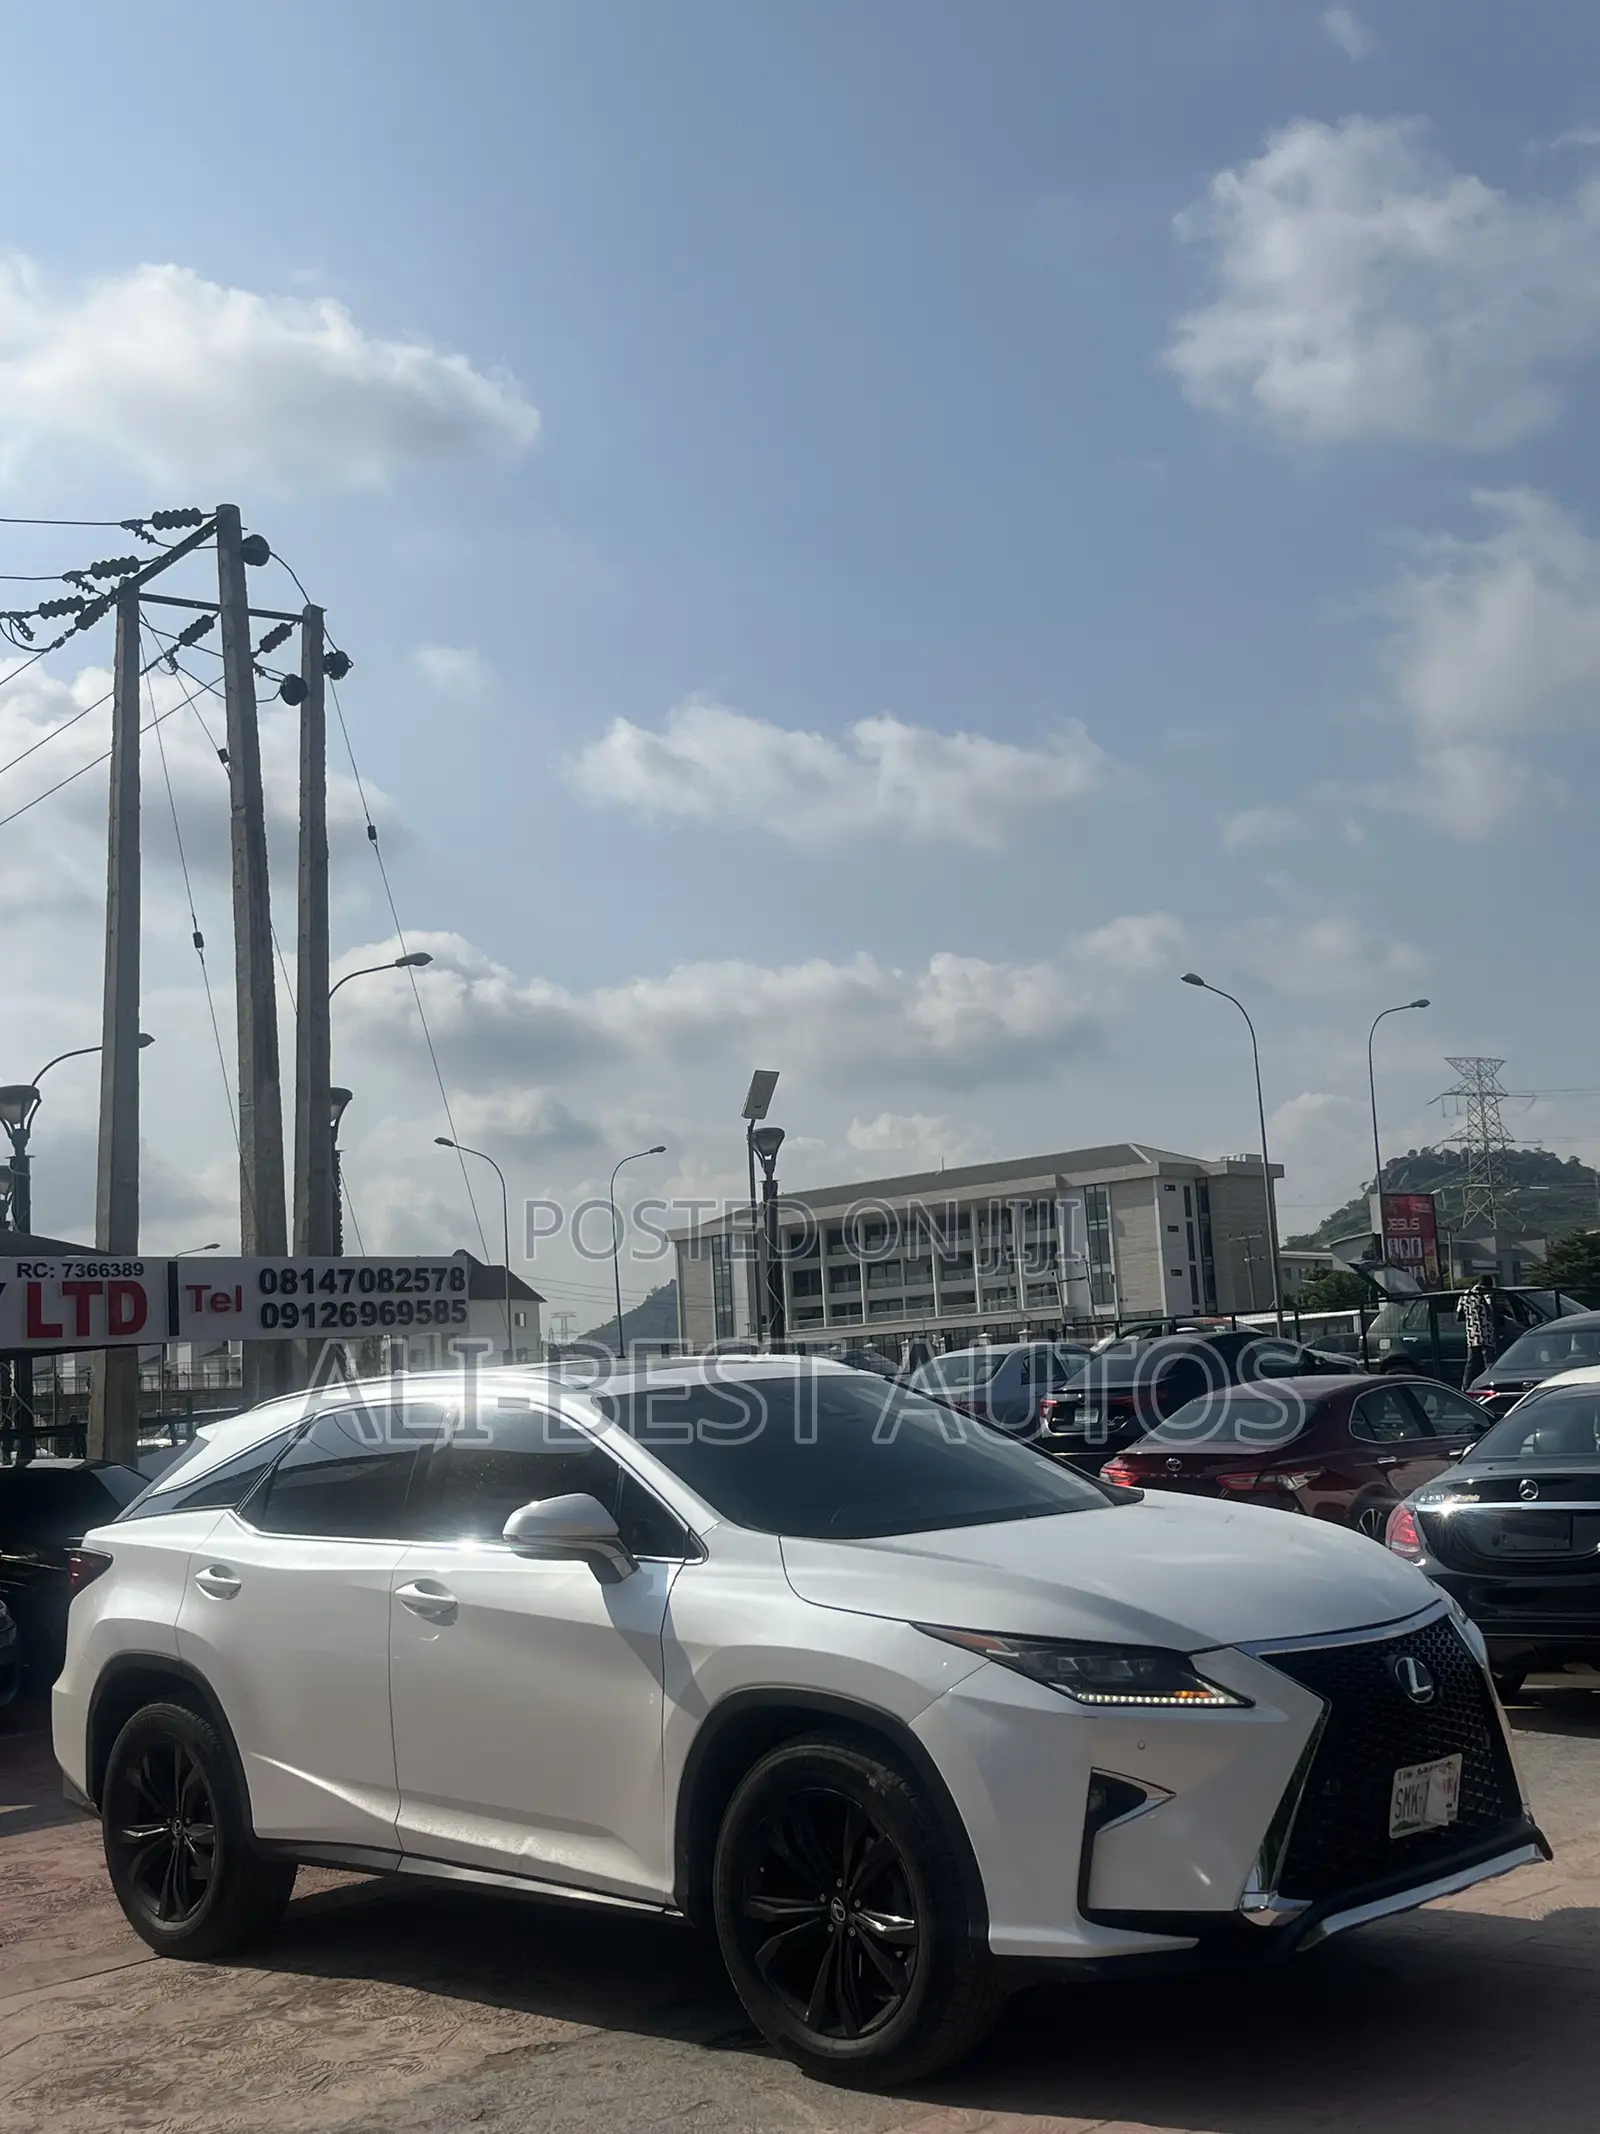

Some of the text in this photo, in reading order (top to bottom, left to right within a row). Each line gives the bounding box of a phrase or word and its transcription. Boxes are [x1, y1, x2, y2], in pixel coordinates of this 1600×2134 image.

[1387, 1217, 1420, 1231] JESUS
[16, 1262, 144, 1278] RC: 7366389
[259, 1266, 466, 1295] 08147082578
[26, 1280, 148, 1338] LTD
[186, 1284, 243, 1313] Tel
[260, 1299, 468, 1329] 09126969585
